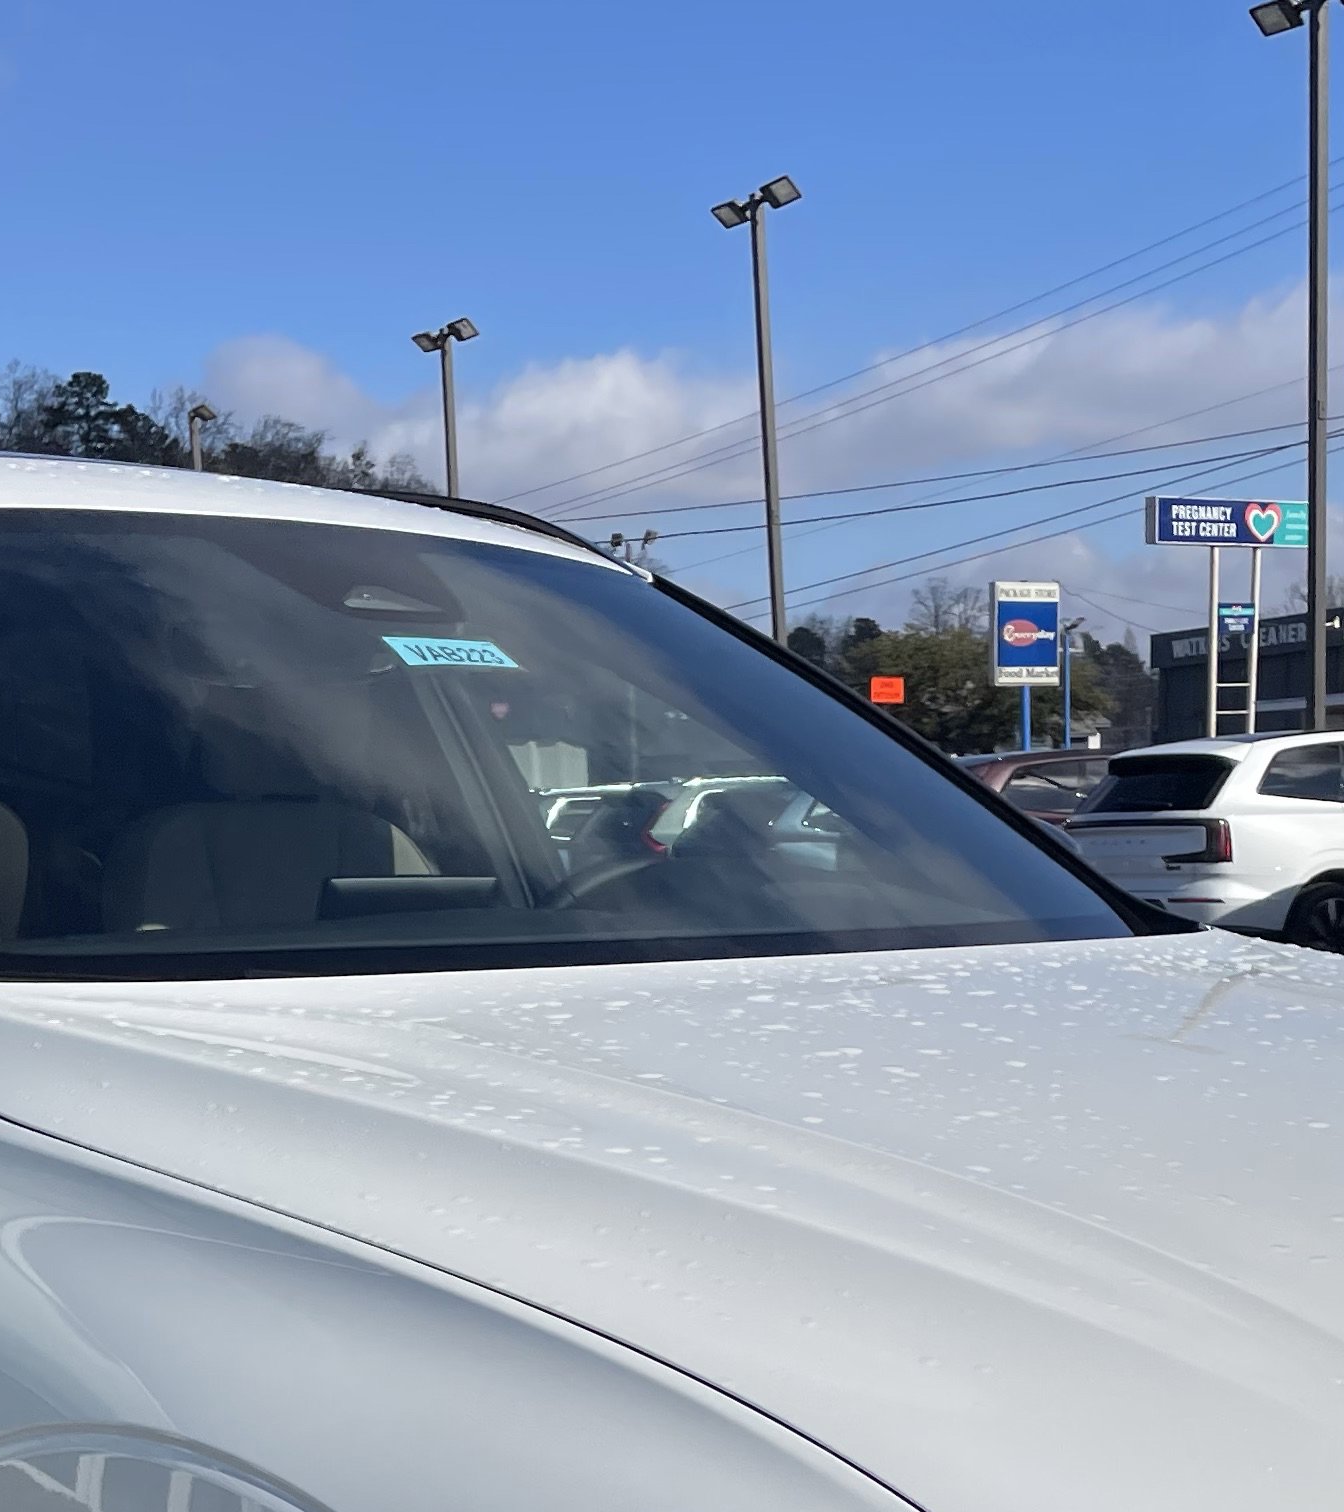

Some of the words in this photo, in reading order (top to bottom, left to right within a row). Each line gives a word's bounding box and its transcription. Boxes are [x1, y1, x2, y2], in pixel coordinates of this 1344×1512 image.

[1171, 504, 1233, 521] PREGNANCY
[1172, 522, 1197, 537] TEST
[1199, 522, 1237, 538] CENTER
